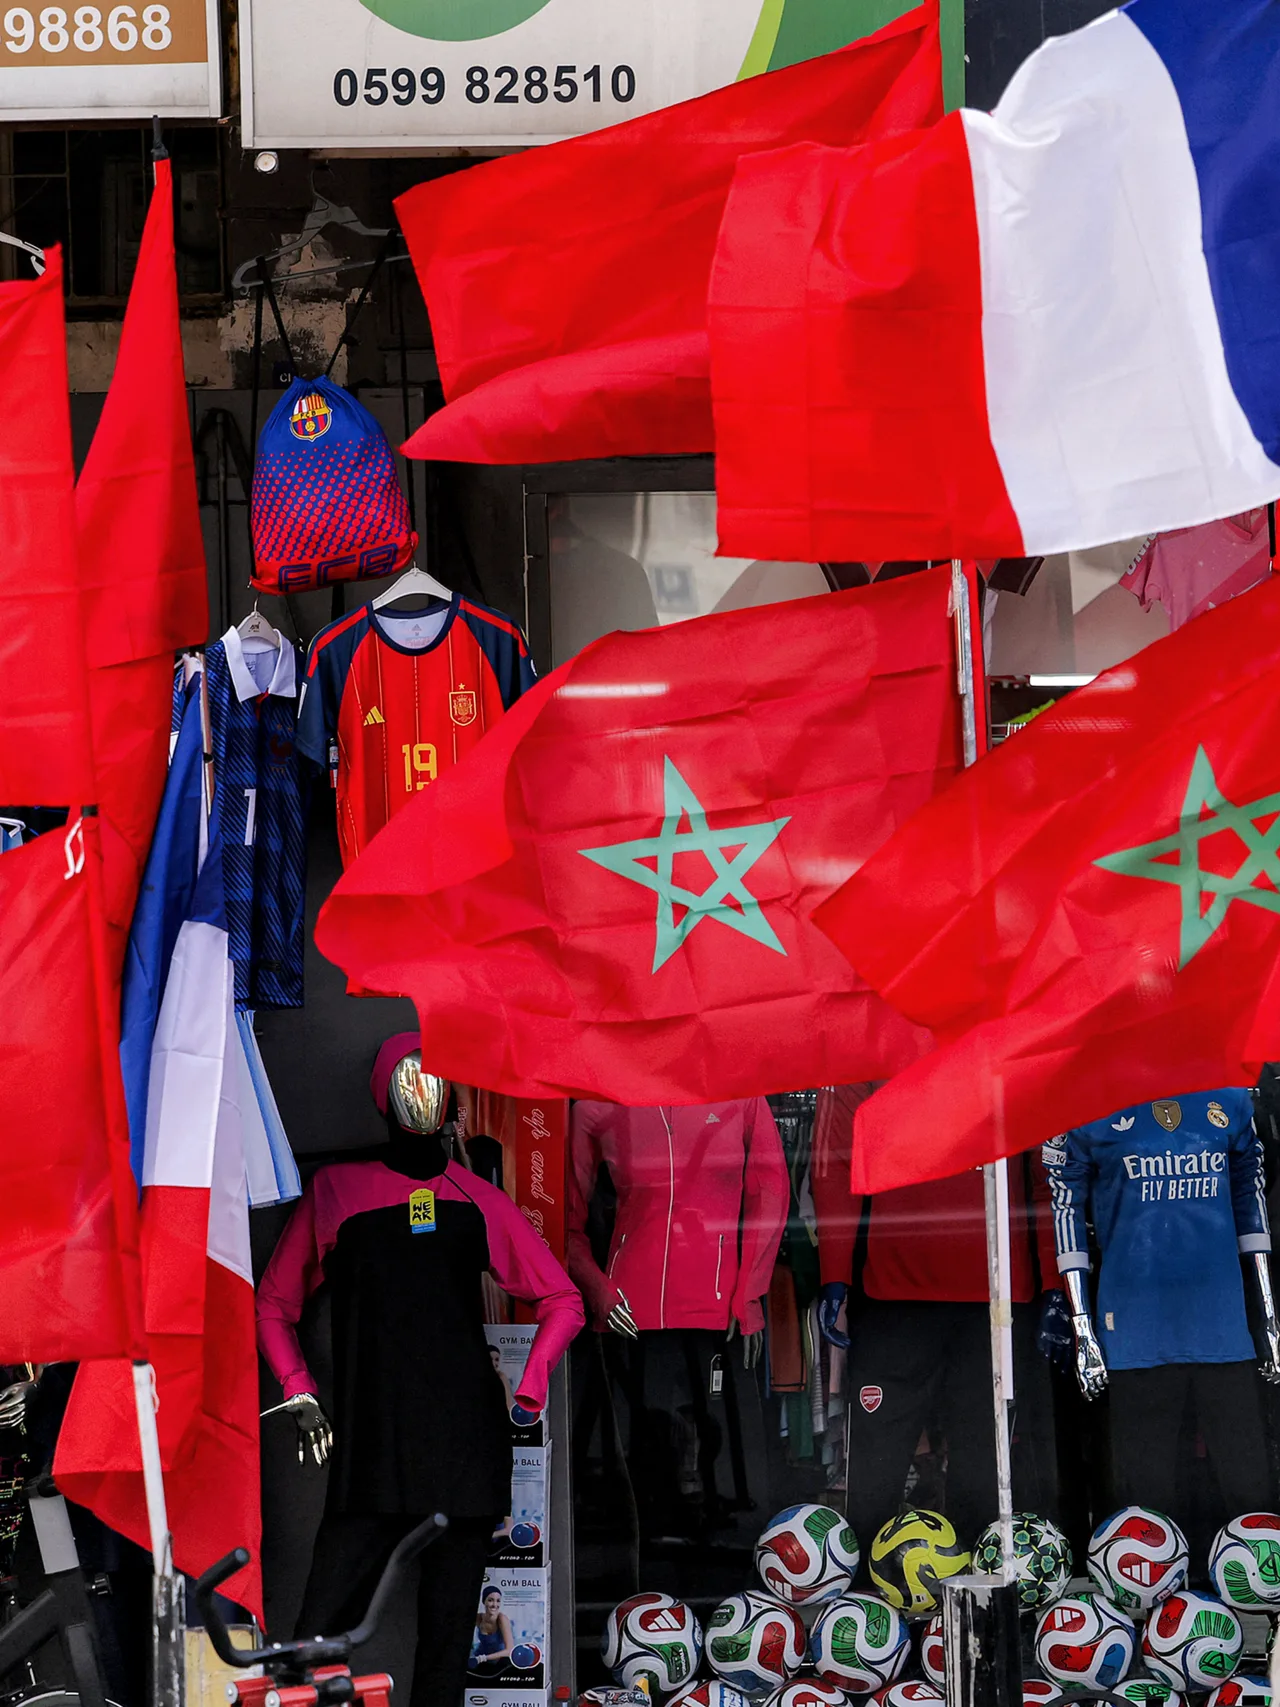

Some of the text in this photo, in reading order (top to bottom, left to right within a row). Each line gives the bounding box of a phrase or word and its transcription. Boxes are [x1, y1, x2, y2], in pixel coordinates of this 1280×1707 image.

[0, 4, 172, 53] 98868
[333, 64, 636, 107] 0599 828510
[278, 543, 398, 592] FCB
[402, 743, 437, 792] 19
[523, 1108, 551, 1140] up
[530, 1150, 555, 1205] and
[1141, 1177, 1219, 1202] FLY BETTER
[412, 1200, 432, 1212] WE
[412, 1210, 433, 1222] AR
[499, 1337, 518, 1345] GYM
[521, 1459, 541, 1467] BALL
[500, 1579, 542, 1587] GYM BALL
